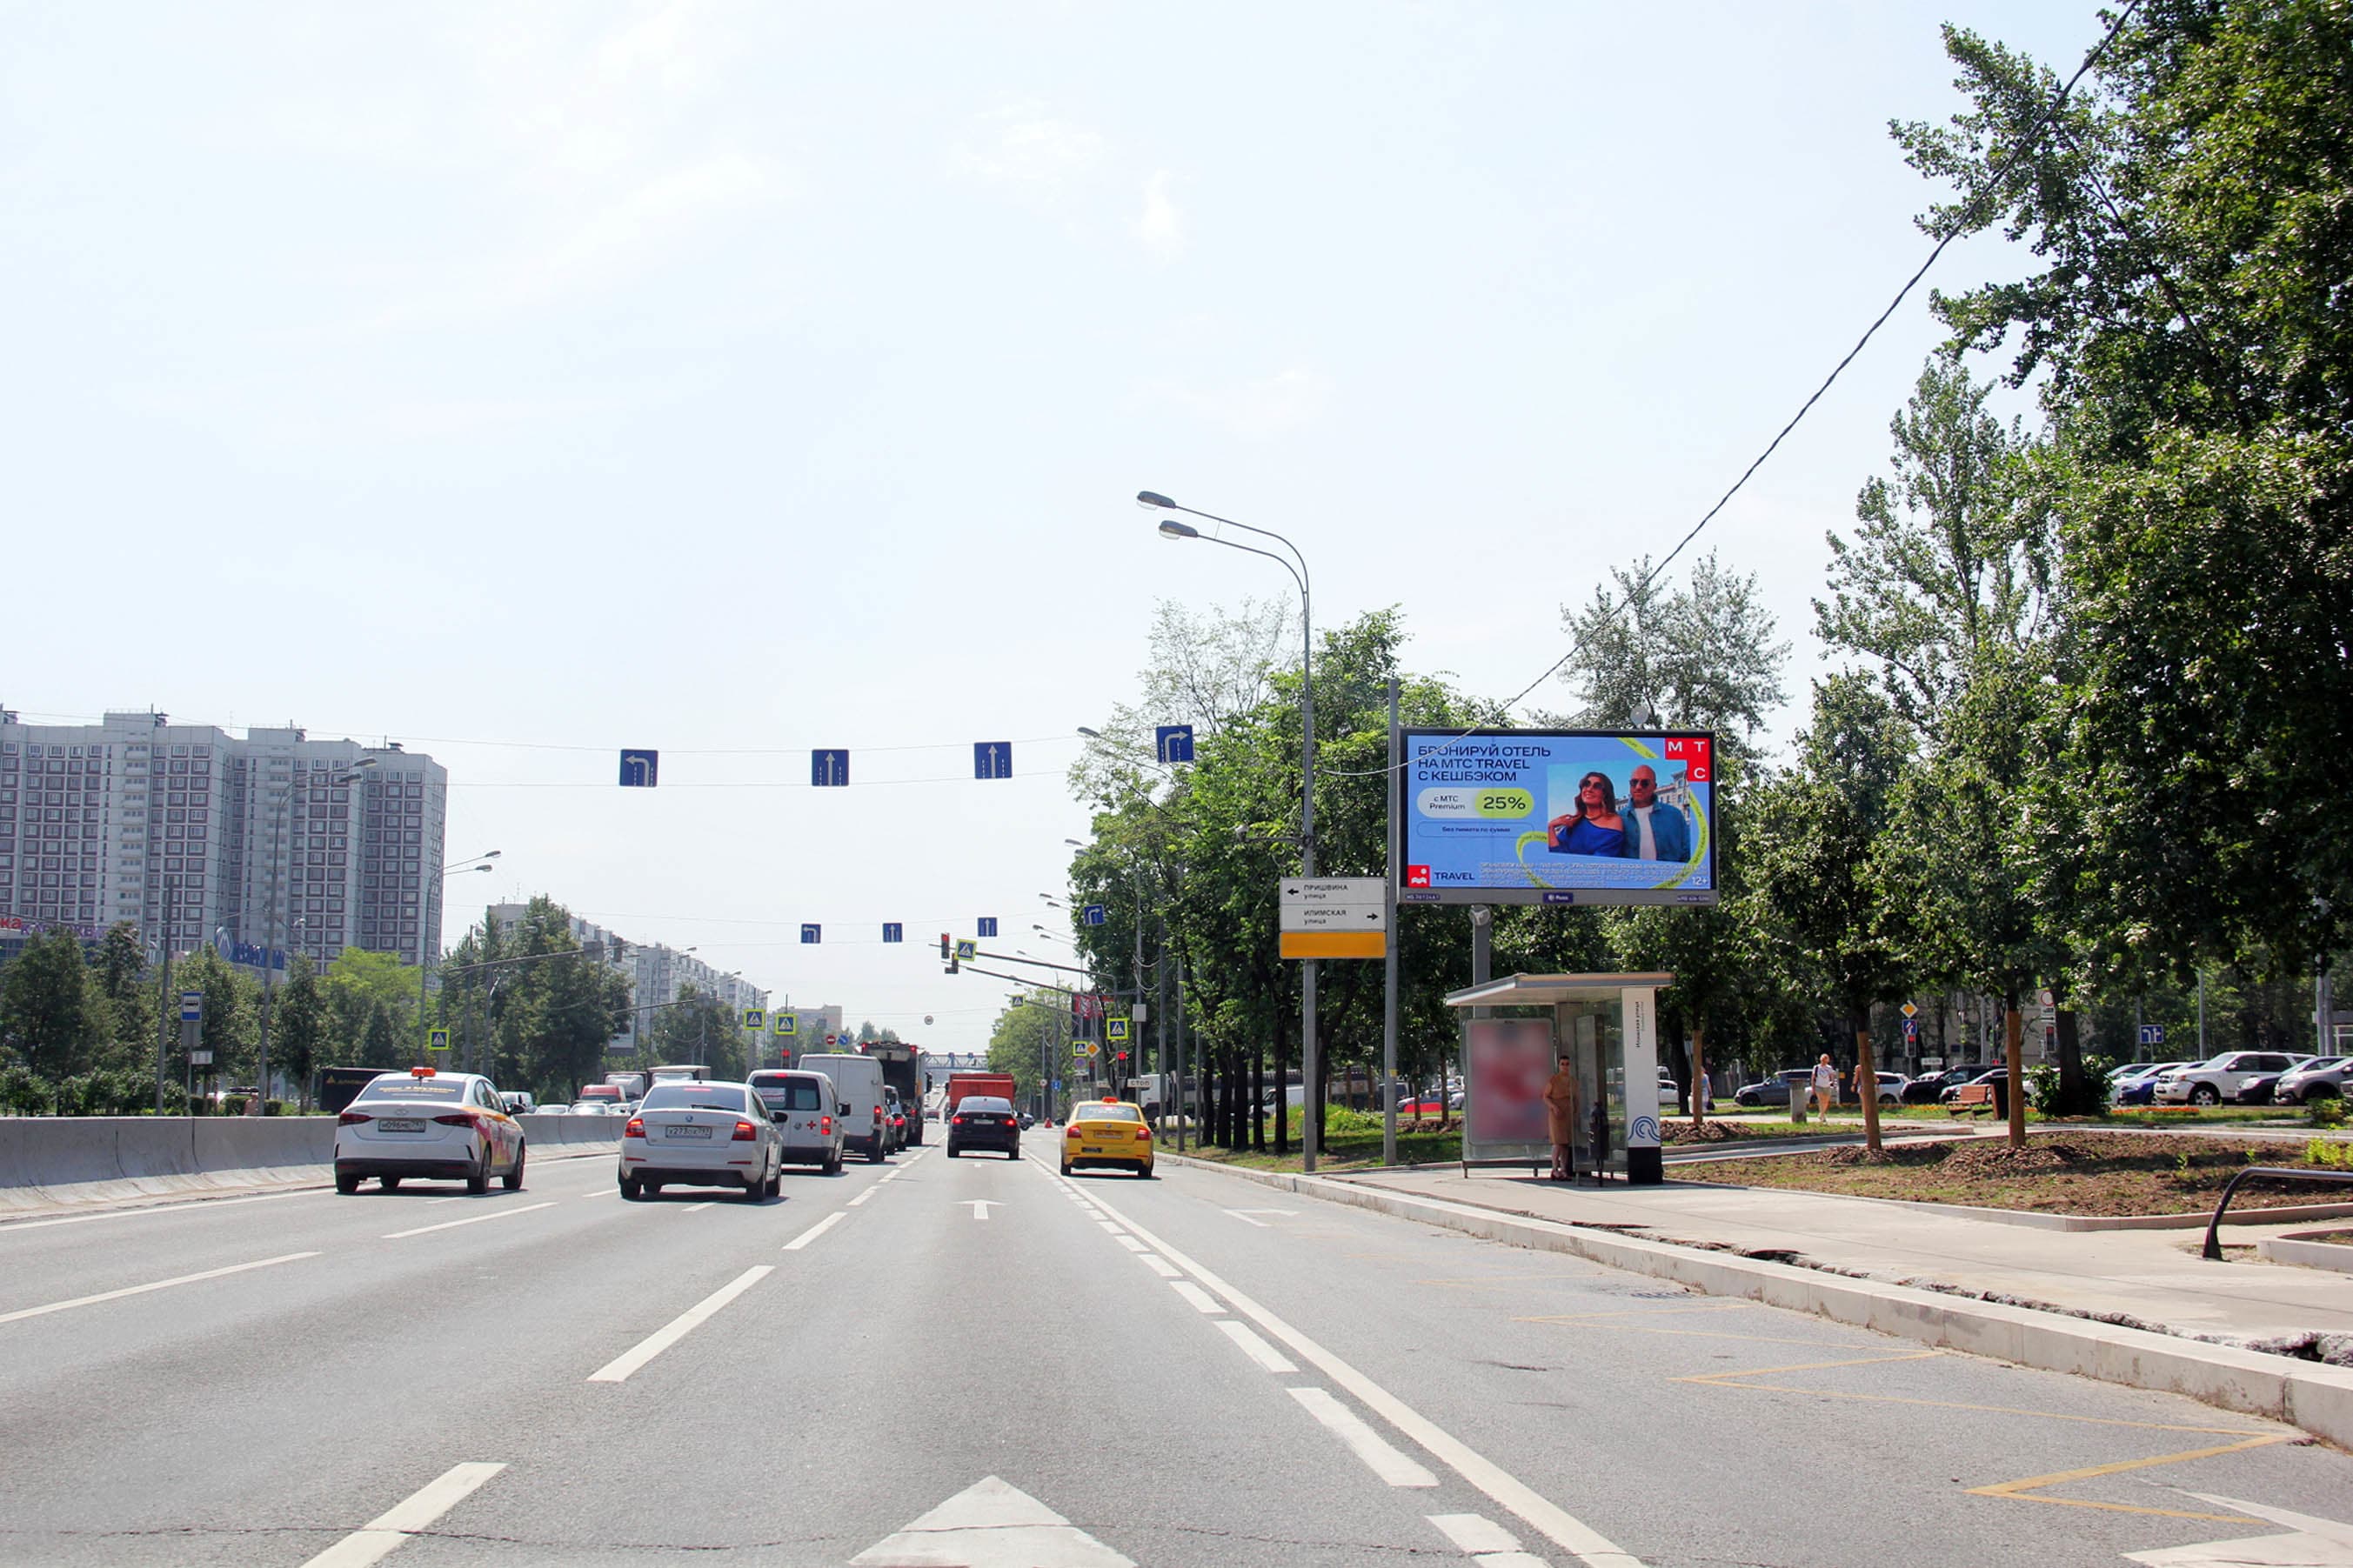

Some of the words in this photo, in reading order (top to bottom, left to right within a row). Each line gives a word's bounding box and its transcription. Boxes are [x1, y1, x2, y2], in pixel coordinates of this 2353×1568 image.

[1418, 744, 1499, 757] БРОНИРУЙ
[1501, 746, 1551, 757] ОТЕЛЬ
[1418, 758, 1439, 769] НА
[1441, 758, 1473, 769] МТС
[1475, 759, 1530, 770] TRAVEL
[1418, 771, 1428, 781] С
[1431, 771, 1517, 782] КЕШБЭКОМ
[1429, 802, 1466, 811] Premium
[1483, 796, 1527, 810] 25%
[1434, 871, 1475, 881] TRAVEL
[1692, 876, 1708, 886] 12+
